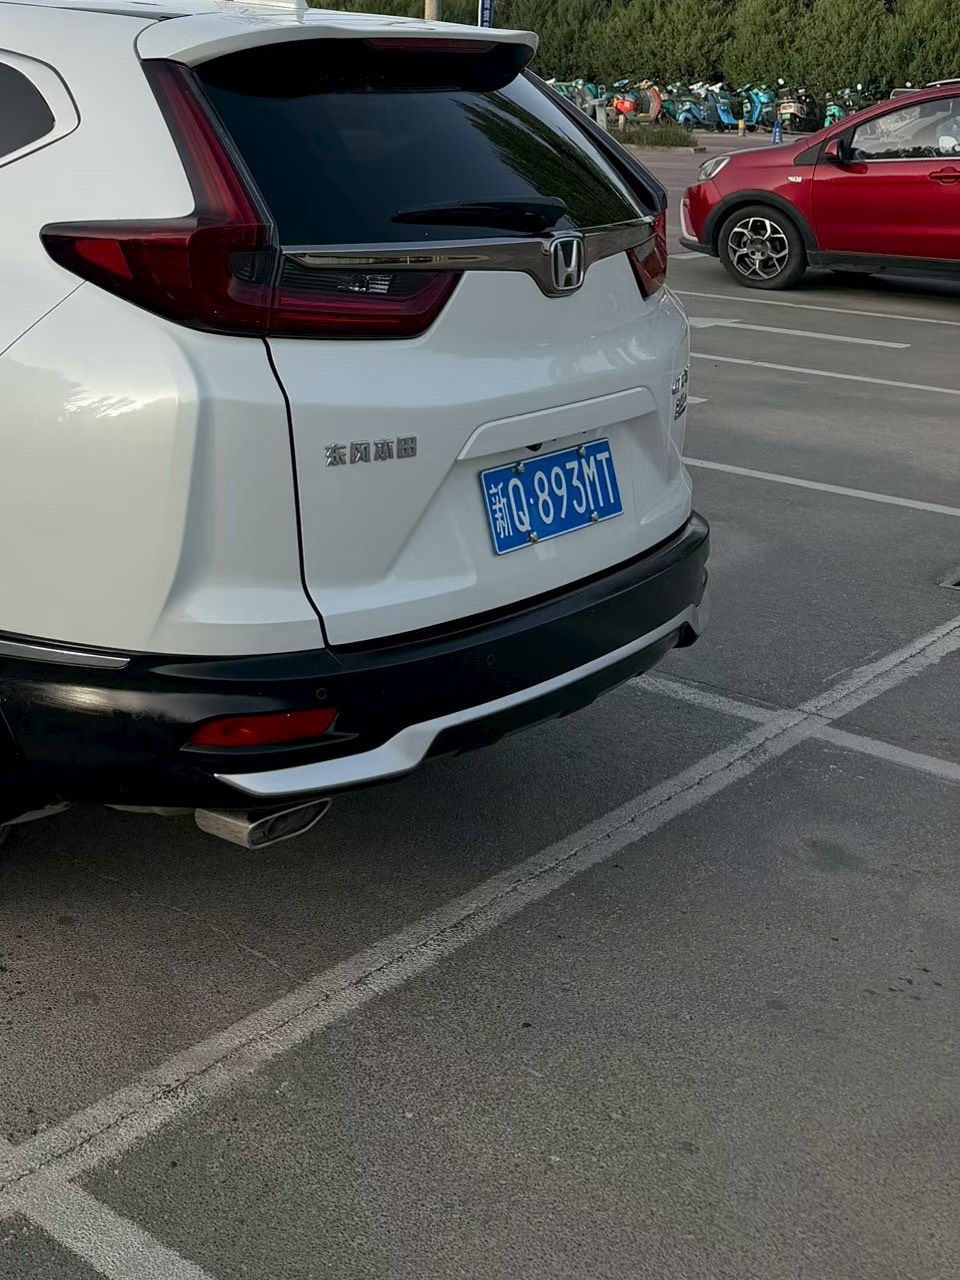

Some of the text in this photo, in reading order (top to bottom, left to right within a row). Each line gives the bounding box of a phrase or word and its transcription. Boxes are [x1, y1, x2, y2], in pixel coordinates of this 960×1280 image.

[325, 436, 418, 467] 东风本田
[489, 451, 615, 539] 新Q·893MT
